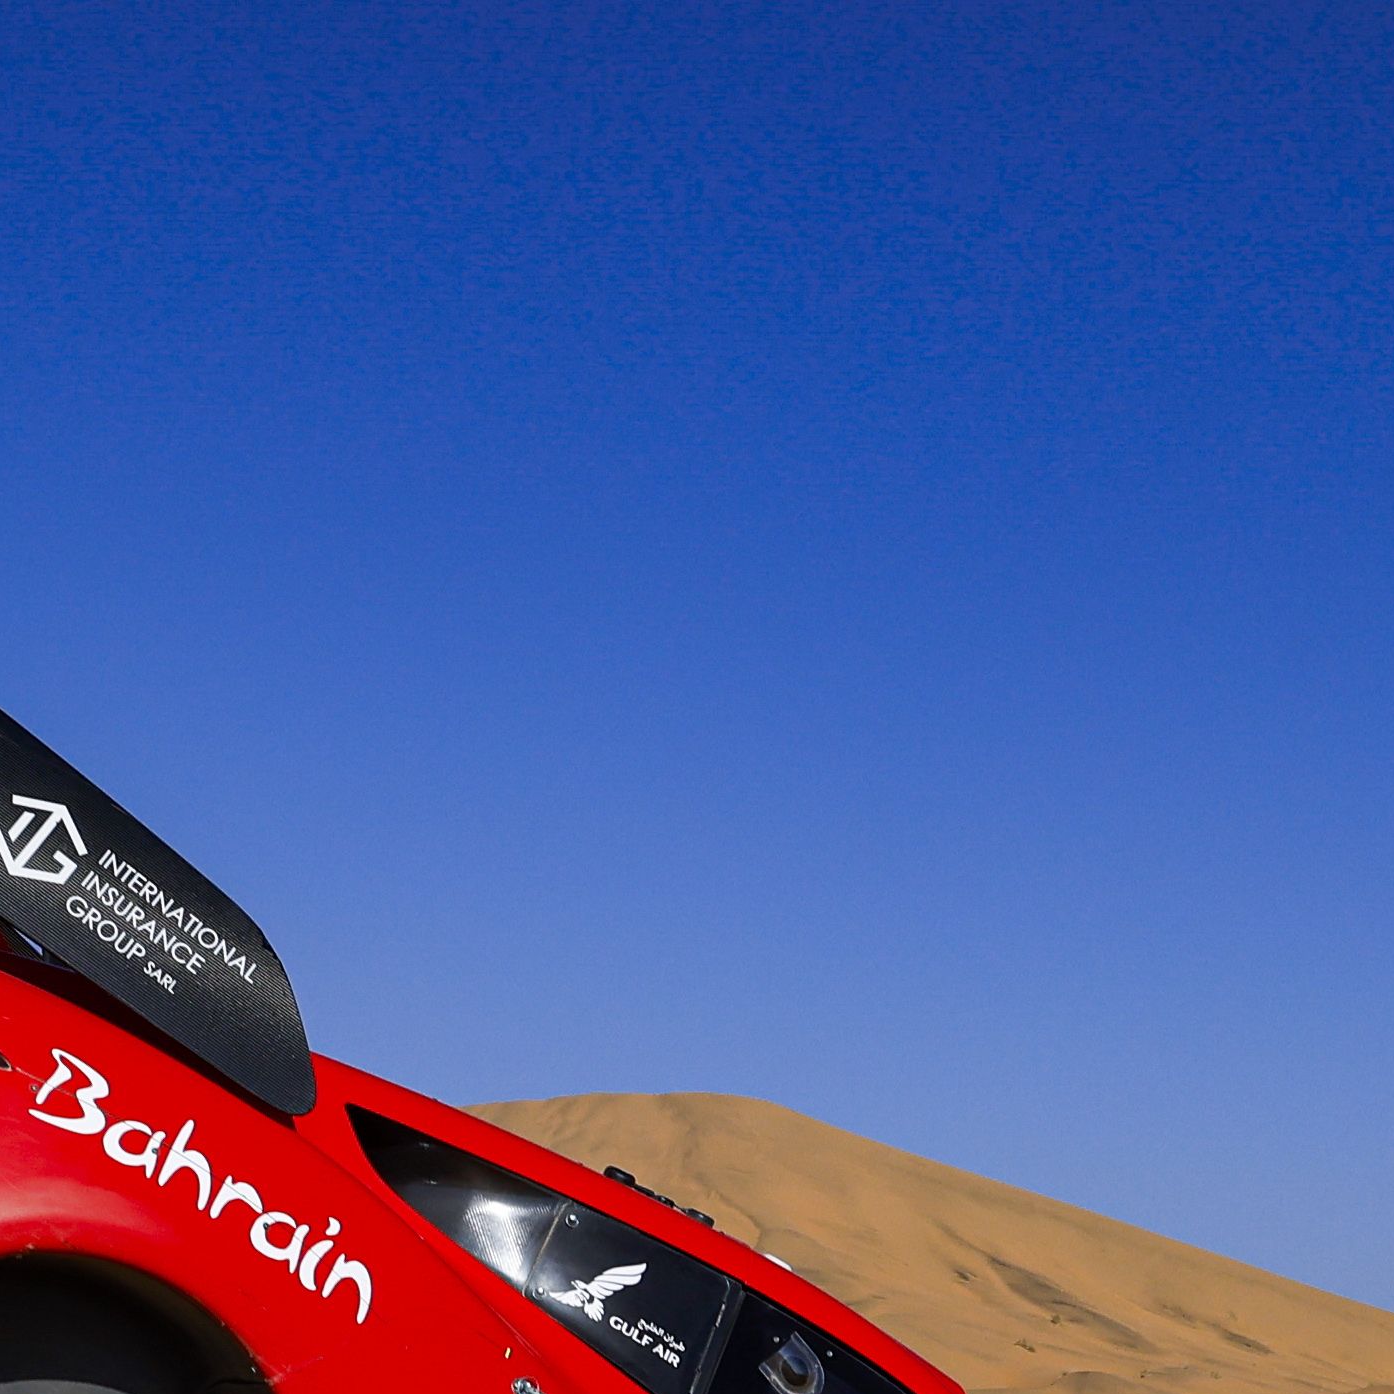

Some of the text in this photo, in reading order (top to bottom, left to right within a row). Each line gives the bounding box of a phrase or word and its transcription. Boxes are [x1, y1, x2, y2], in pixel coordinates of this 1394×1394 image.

[66, 895, 179, 994] GROUP SARL
[81, 870, 206, 975] INSURANCE
[98, 849, 258, 984] INTERNATIONAL
[28, 1048, 372, 1325] Bahrain
[609, 1315, 680, 1368] GULF AIR
